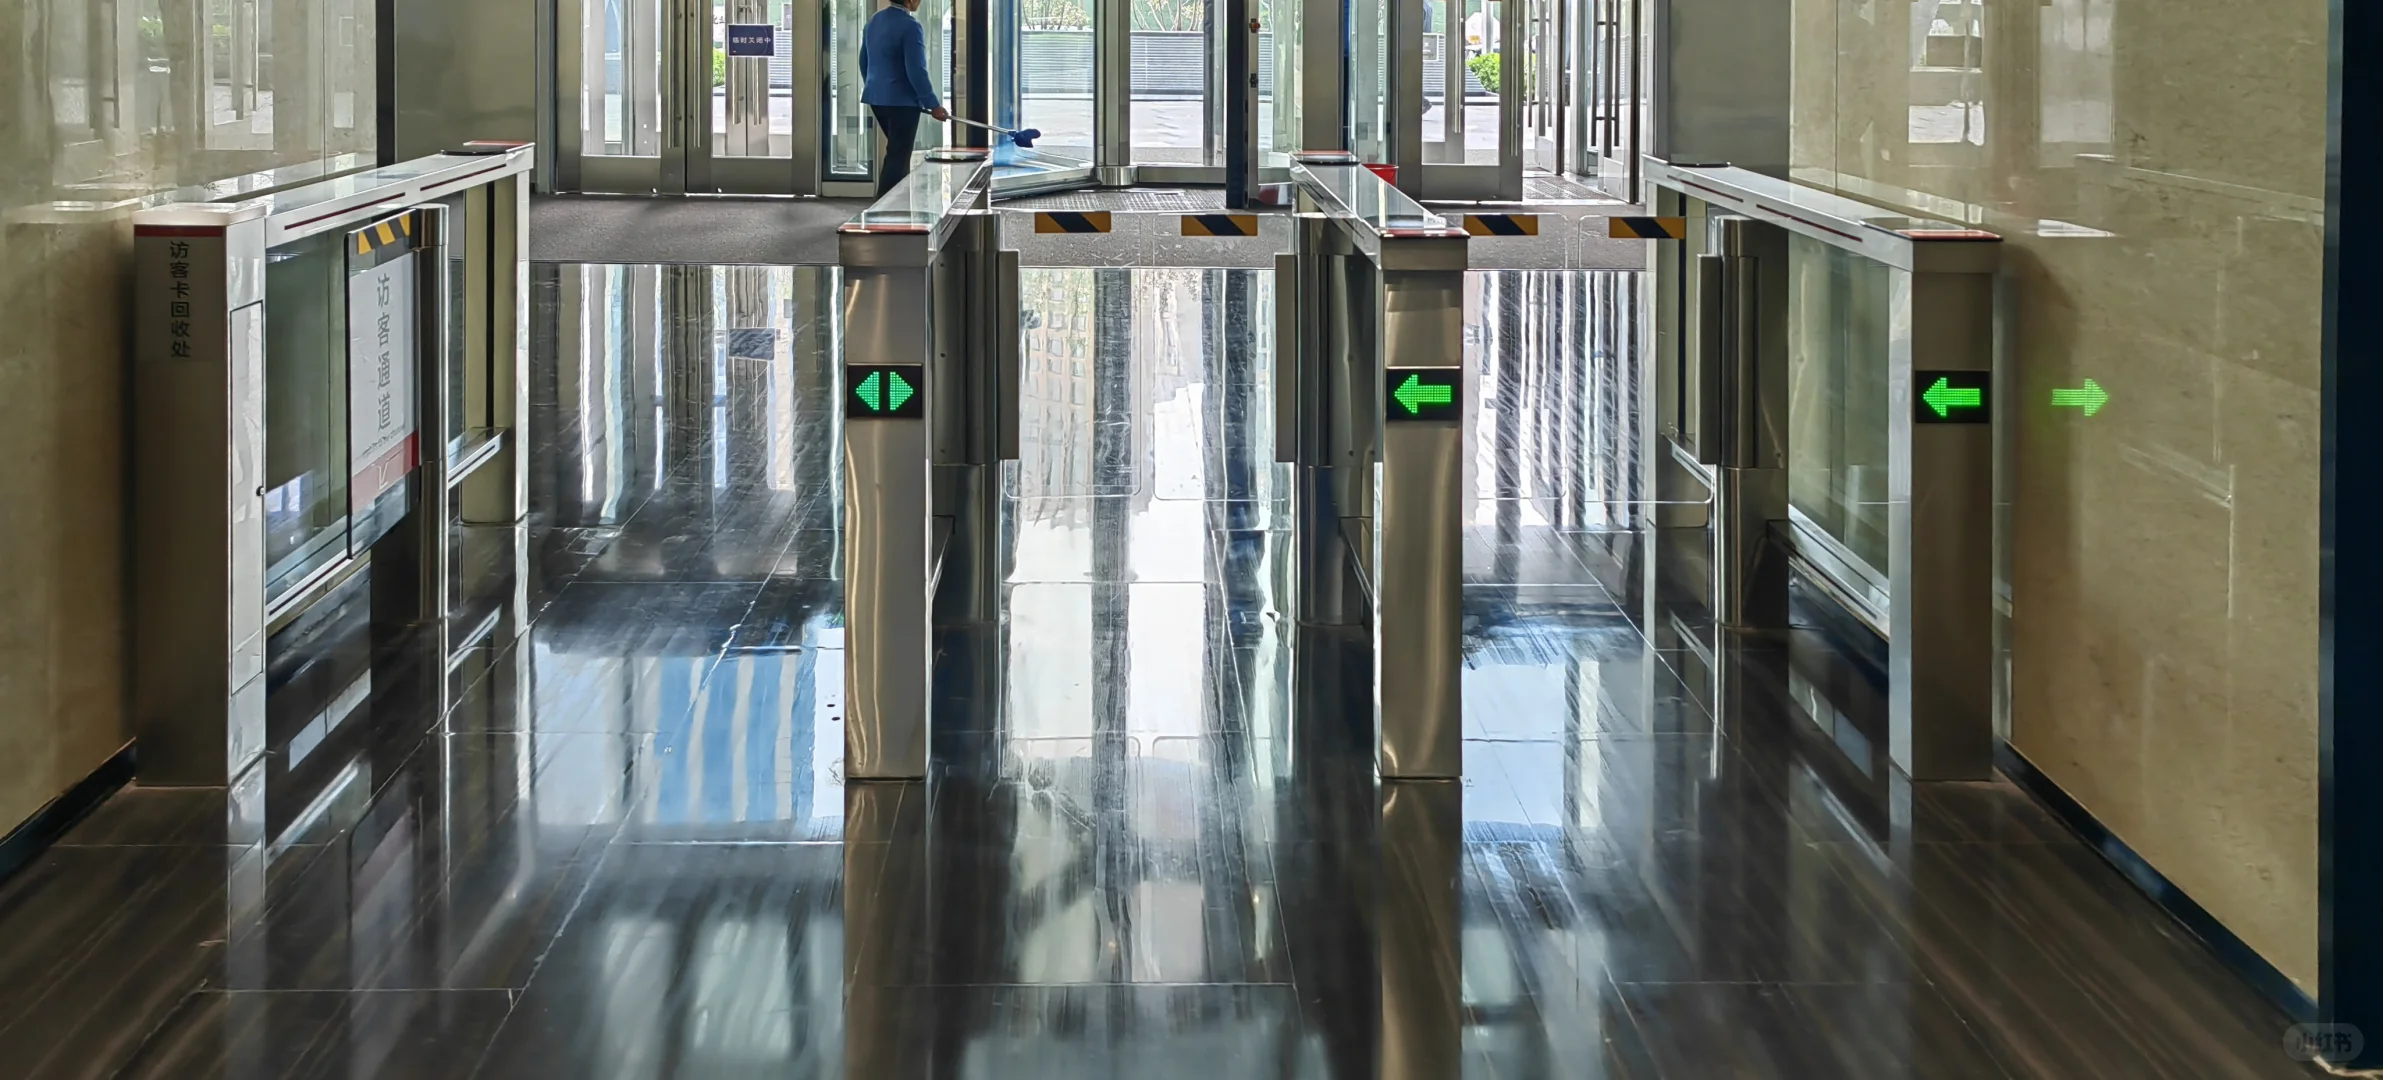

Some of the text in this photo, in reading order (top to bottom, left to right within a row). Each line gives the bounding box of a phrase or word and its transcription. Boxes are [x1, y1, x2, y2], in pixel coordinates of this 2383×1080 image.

[169, 240, 191, 358] 访客卡回收处
[377, 272, 391, 432] 访客通道
